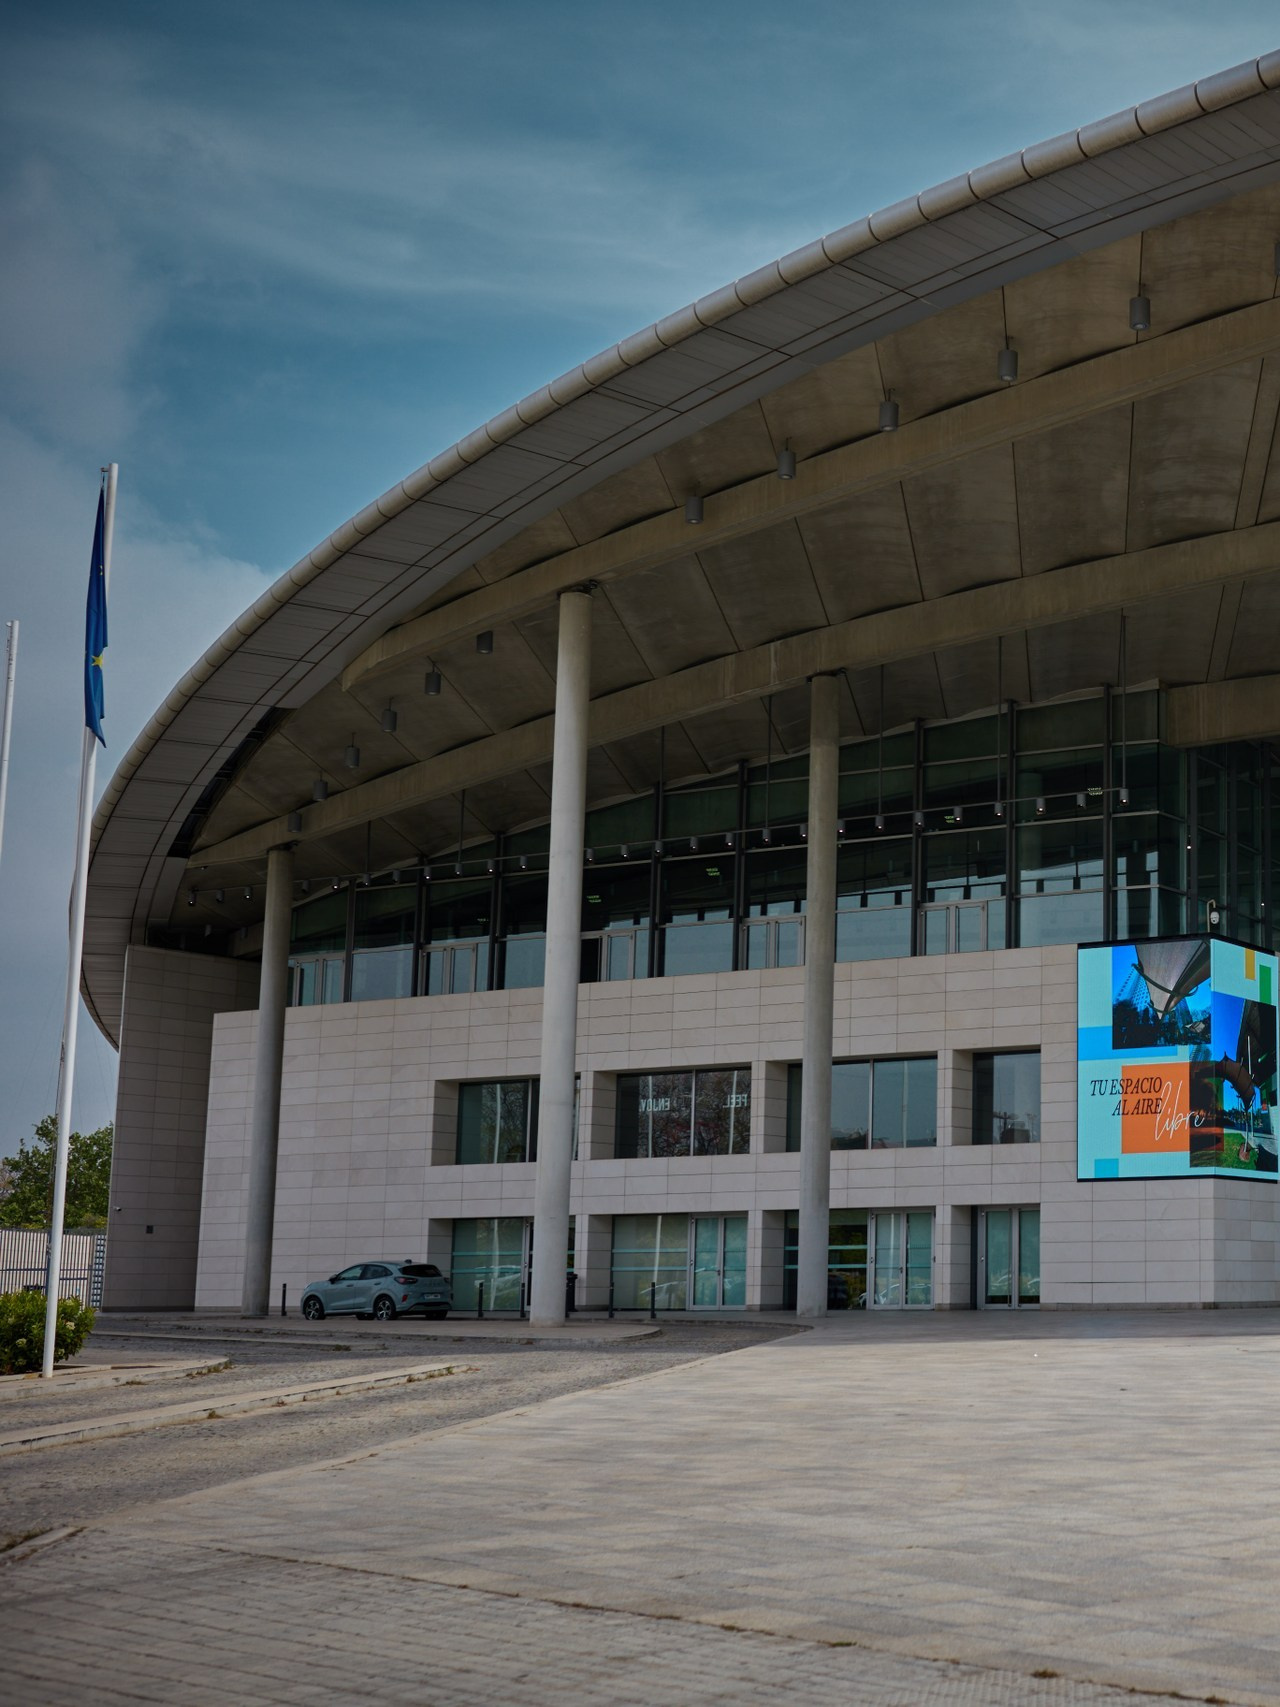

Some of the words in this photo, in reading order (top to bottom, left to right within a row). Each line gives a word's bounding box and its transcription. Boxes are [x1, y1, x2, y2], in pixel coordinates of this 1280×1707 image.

[1090, 1080, 1108, 1096] TU
[1109, 1077, 1163, 1096] ESPACIO
[1112, 1100, 1130, 1116] AL
[1131, 1098, 1163, 1116] AIRE
